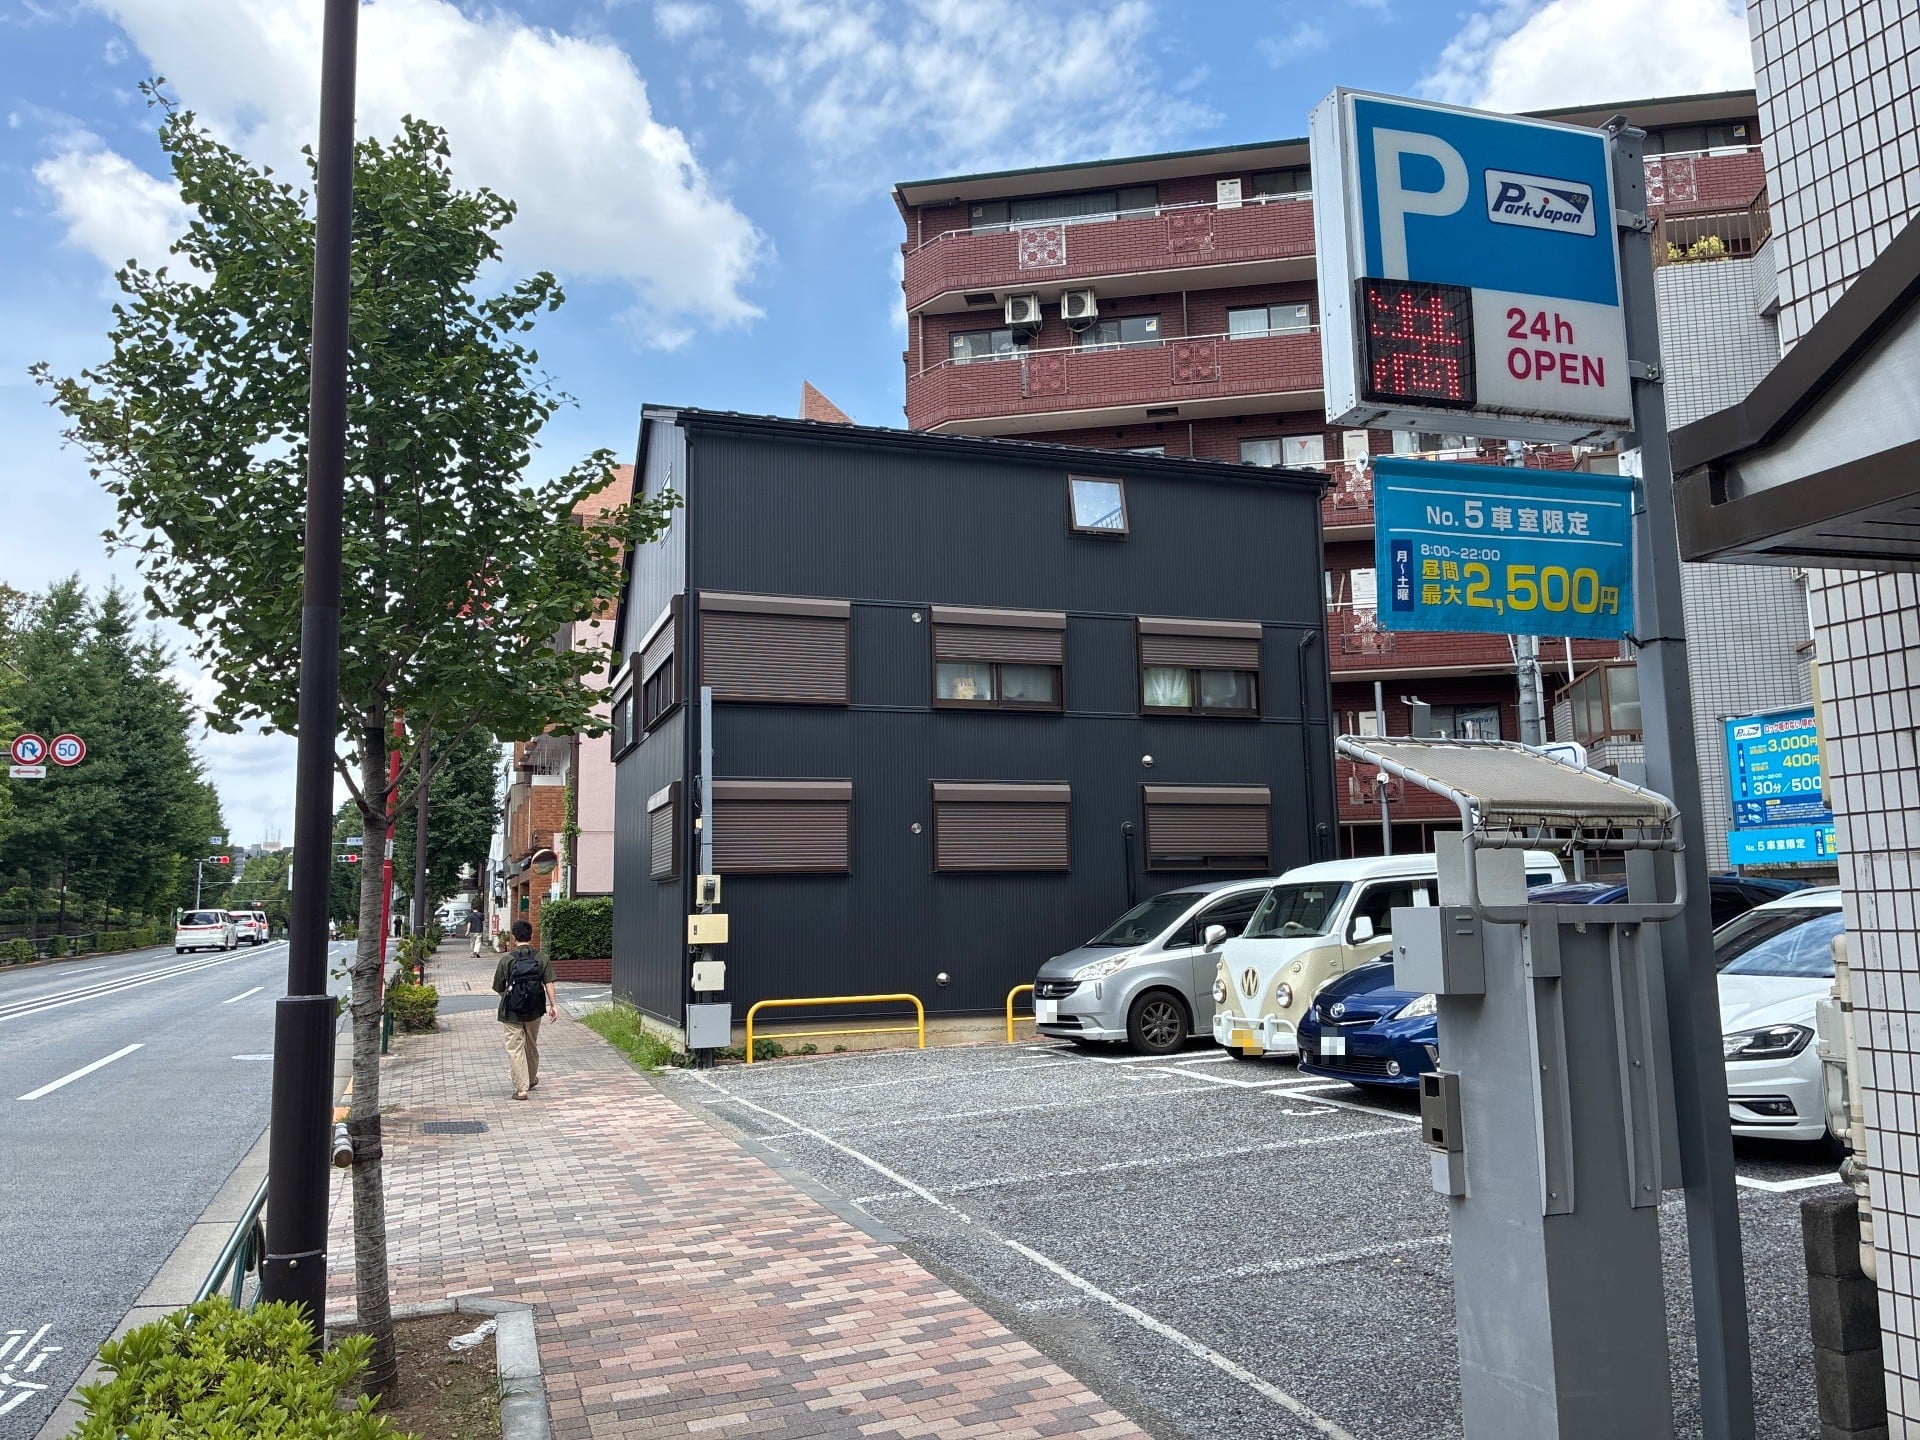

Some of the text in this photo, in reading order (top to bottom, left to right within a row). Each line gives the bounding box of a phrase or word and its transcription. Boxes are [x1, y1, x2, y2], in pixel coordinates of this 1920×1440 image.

[1373, 127, 1469, 279] P
[1506, 308, 1573, 344] 24h
[1507, 347, 1605, 387] OPEN
[1422, 560, 1460, 582] 昼間
[1421, 584, 1463, 606] 最大
[58, 743, 77, 756] 50
